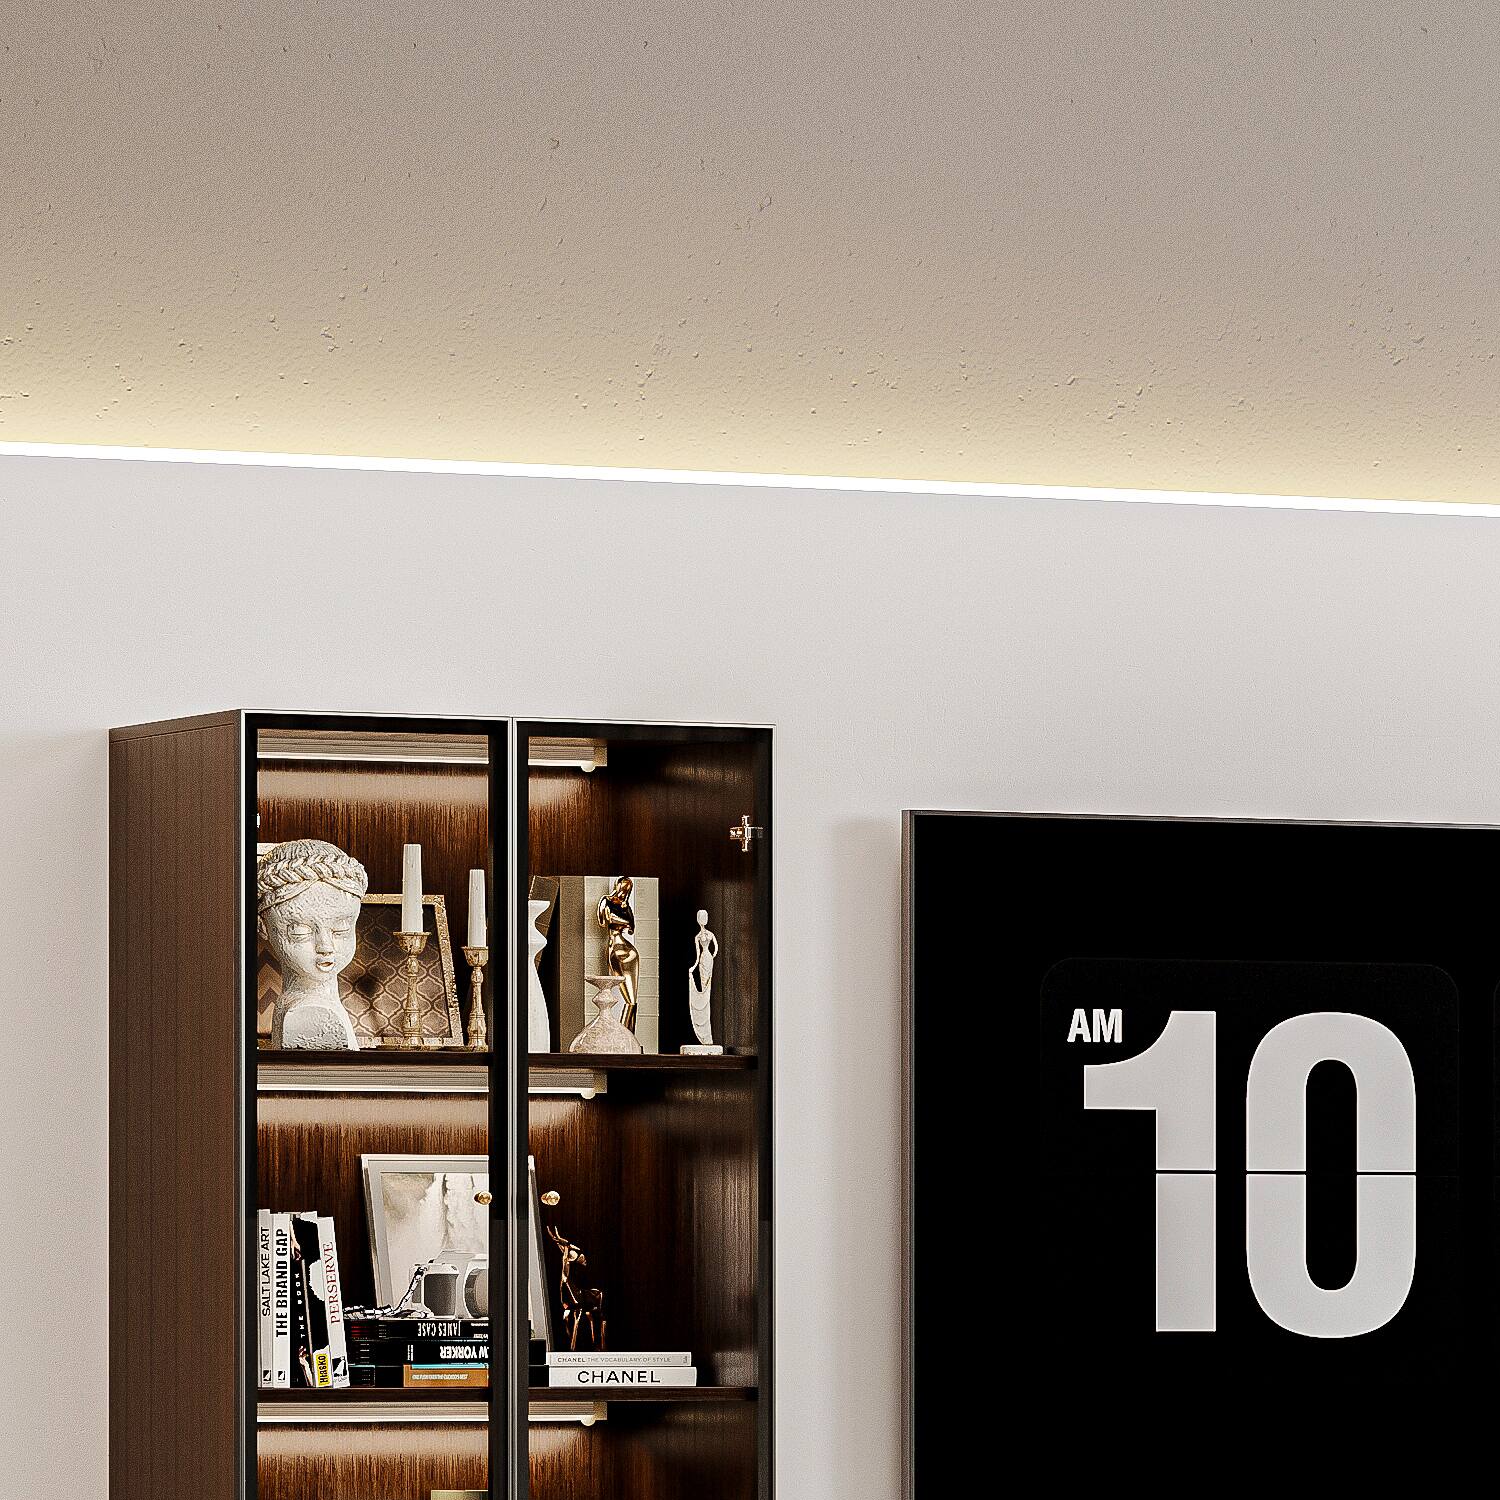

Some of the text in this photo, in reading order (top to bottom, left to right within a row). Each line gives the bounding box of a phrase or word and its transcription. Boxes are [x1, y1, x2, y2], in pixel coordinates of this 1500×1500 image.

[1066, 1008, 1122, 1043] AM
[1083, 1010, 1417, 1338] 10
[260, 1227, 271, 1317] SALT LAKE ART
[276, 1228, 288, 1337] THE BRAND GAP
[323, 1241, 341, 1324] PERSERVE
[417, 1322, 437, 1337] CASE
[440, 1346, 478, 1359] YORKER
[577, 1370, 661, 1384] CHANEL
